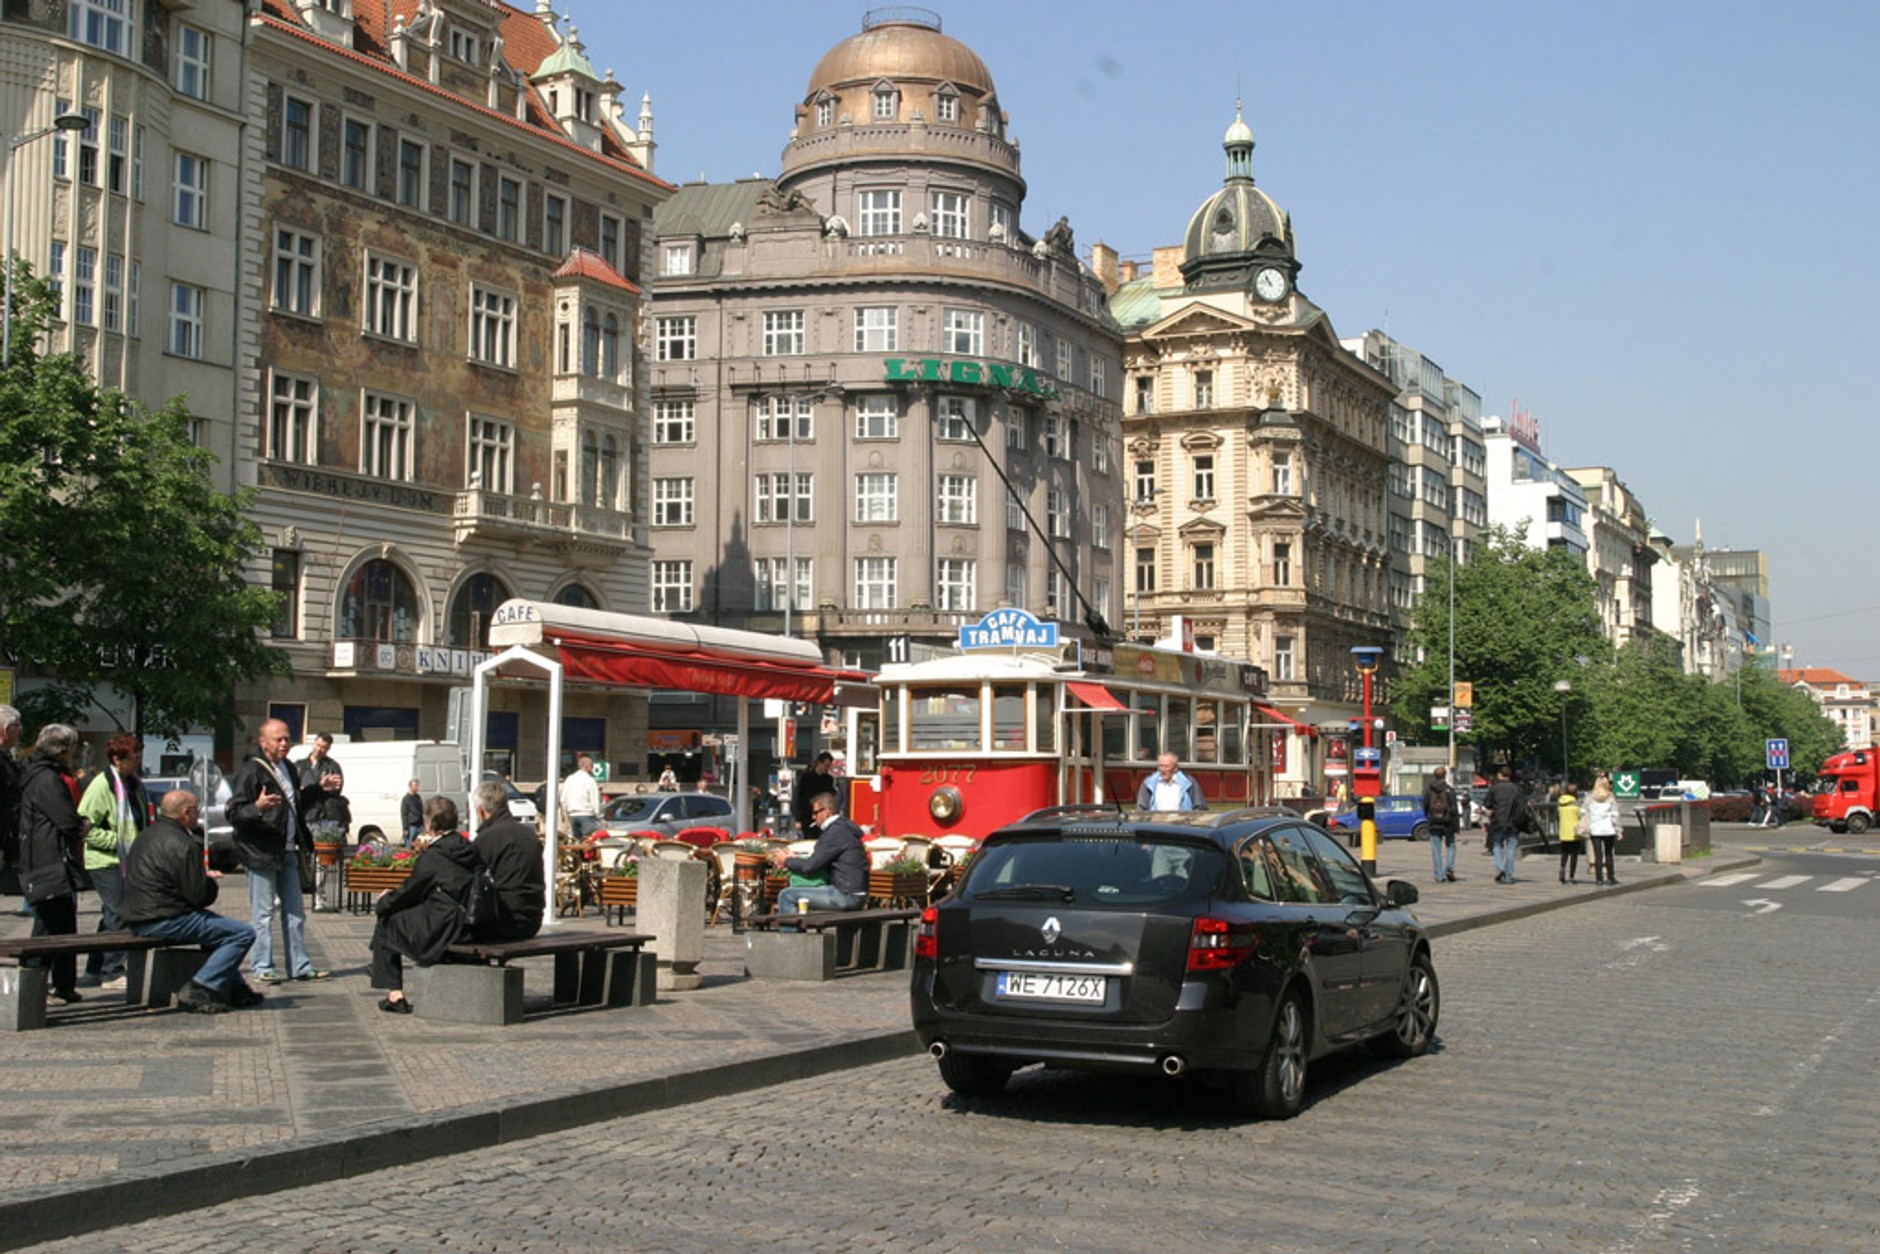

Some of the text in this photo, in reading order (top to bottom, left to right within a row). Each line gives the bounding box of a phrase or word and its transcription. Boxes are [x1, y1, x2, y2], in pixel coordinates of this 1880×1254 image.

[884, 358, 1042, 394] LIGNA
[497, 605, 533, 624] CAFE
[987, 612, 1027, 629] CAFE
[969, 625, 1048, 645] TRAMVAJ
[889, 638, 905, 662] 11
[919, 764, 977, 784] 2077
[1013, 949, 1095, 958] LAGUNA
[1010, 973, 1102, 997] WE 7126X
